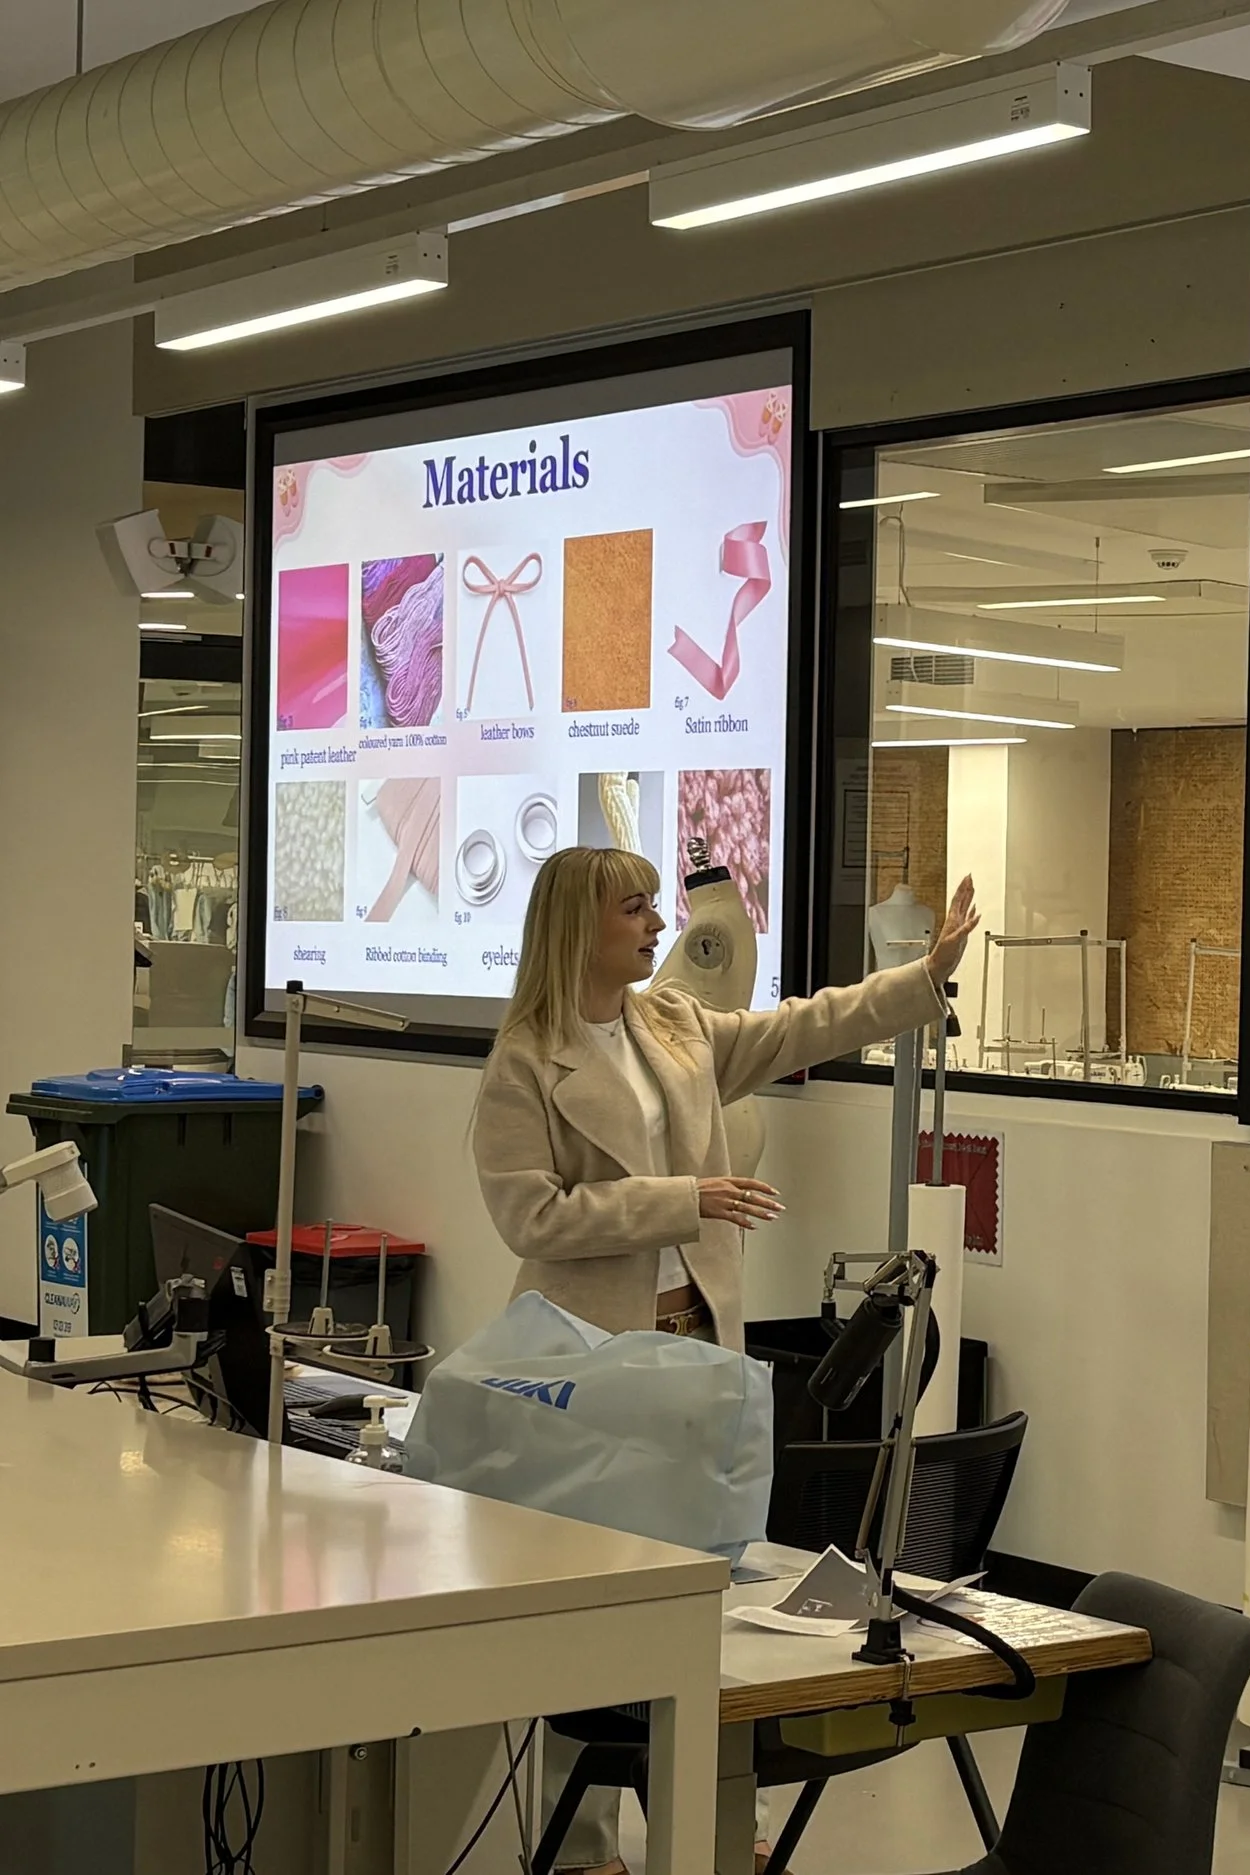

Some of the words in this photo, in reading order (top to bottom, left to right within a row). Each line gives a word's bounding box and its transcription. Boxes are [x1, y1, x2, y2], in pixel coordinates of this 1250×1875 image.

[422, 434, 590, 508] Materials
[480, 724, 510, 740] leather
[512, 722, 535, 740] bows
[568, 720, 609, 738] chestnut
[611, 717, 640, 737] suede
[685, 716, 712, 734] Satin
[714, 714, 749, 733] ribbon
[358, 735, 387, 750] coloured
[280, 748, 299, 769] pink
[300, 749, 326, 768] patent
[328, 746, 357, 764] leather
[293, 945, 326, 966] shearing
[365, 946, 392, 963] Ribbed
[418, 947, 448, 967] binding
[482, 945, 520, 970] eyelets
[771, 976, 780, 998] 5
[480, 1378, 576, 1410] JUKI
